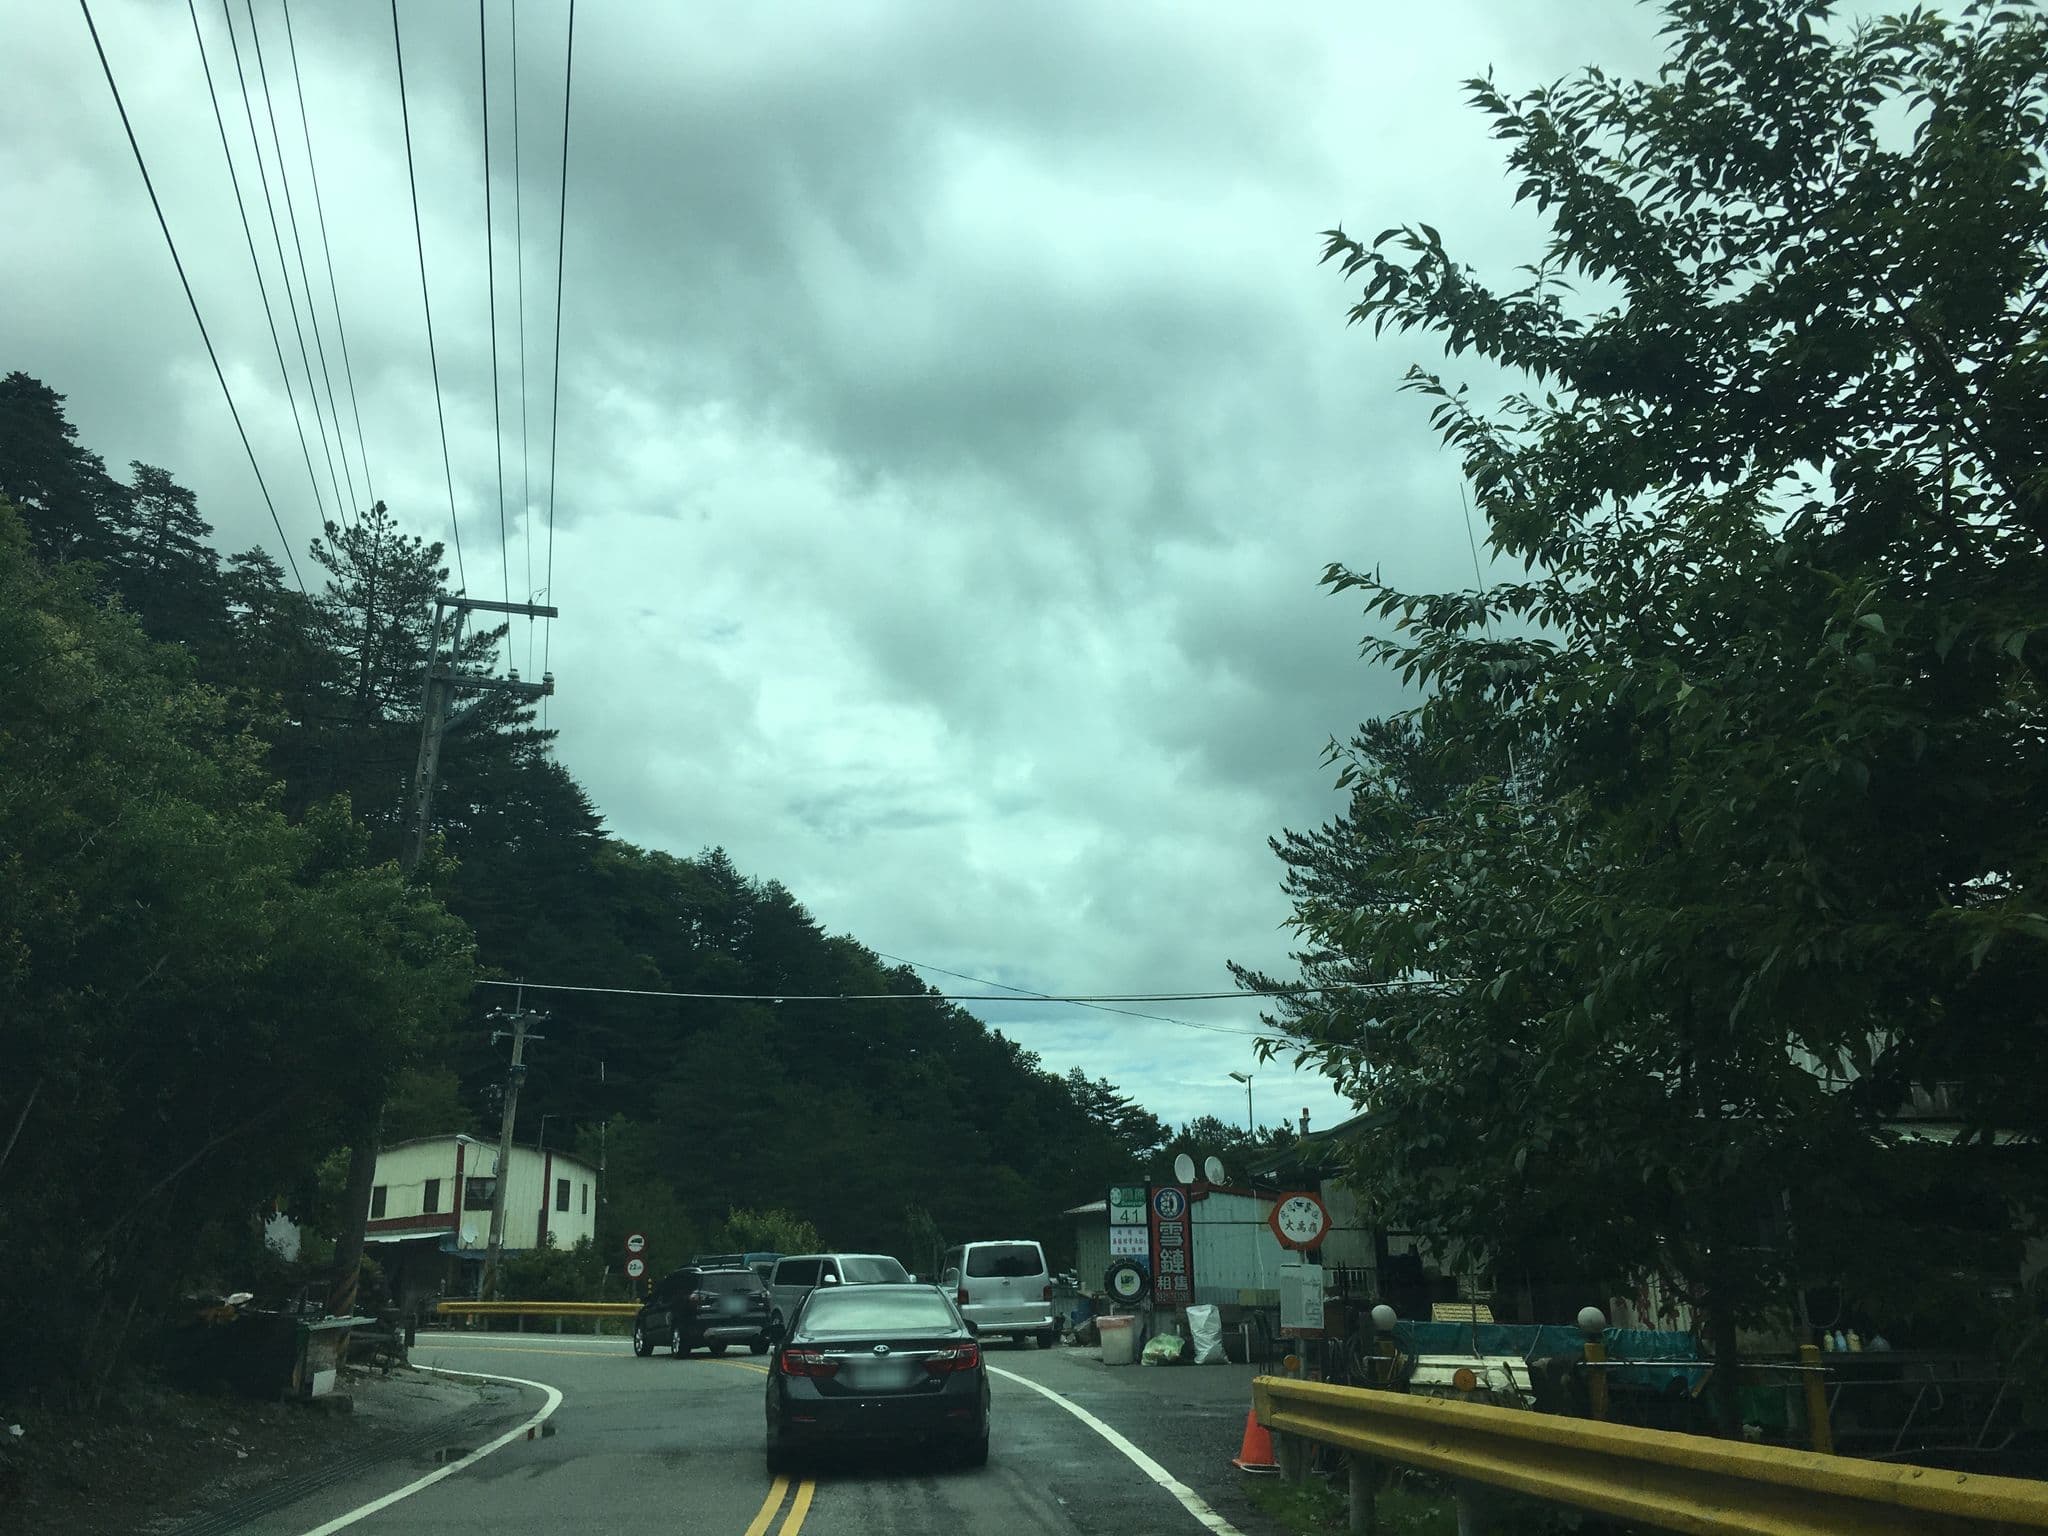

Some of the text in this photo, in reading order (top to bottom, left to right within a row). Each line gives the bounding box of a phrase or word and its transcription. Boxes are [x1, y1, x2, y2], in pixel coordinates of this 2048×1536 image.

[1120, 1208, 1138, 1224] 41
[1159, 1221, 1185, 1274] 雪鏈
[1157, 1275, 1188, 1291] 租售
